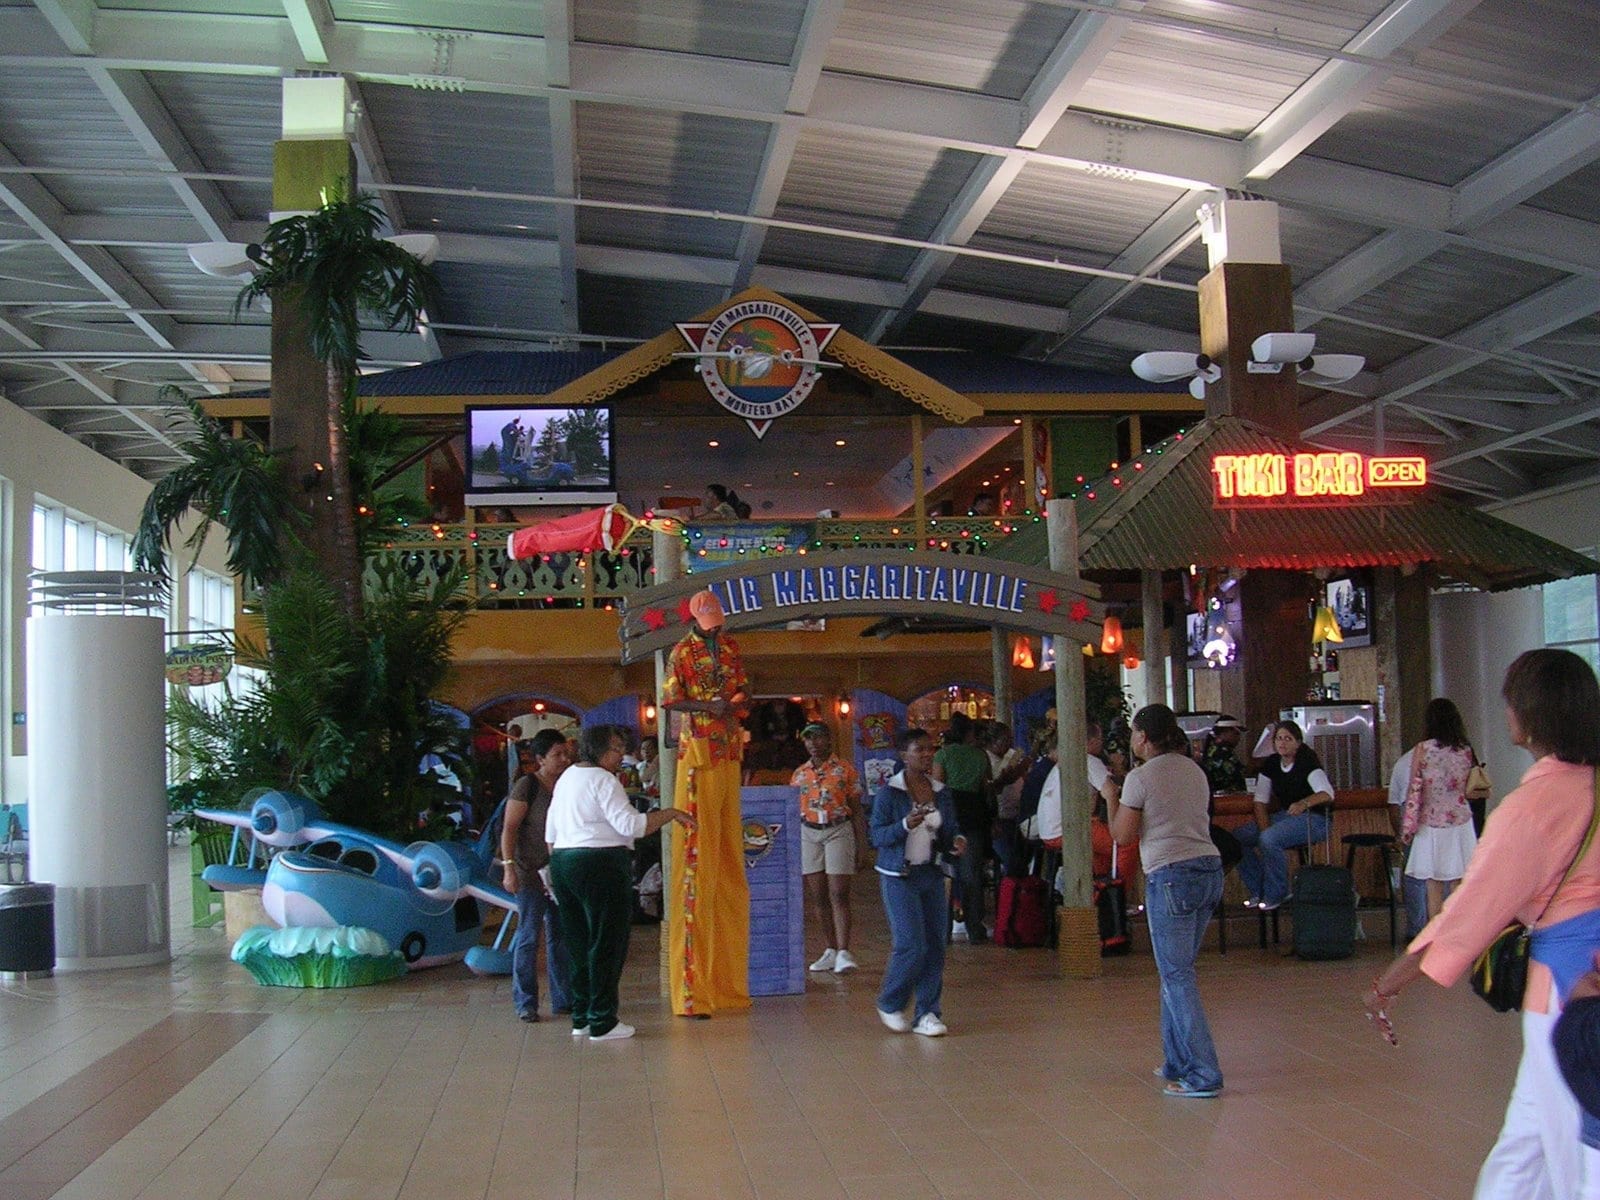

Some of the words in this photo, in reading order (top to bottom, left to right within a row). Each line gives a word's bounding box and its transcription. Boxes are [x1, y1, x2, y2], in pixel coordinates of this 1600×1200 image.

[710, 319, 728, 338] AIR
[725, 303, 808, 338] MARGARITAVILLE
[725, 395, 772, 415] MONTEGO
[776, 394, 797, 413] BAY
[1213, 453, 1287, 498] TIKI
[1294, 452, 1365, 497] BAR
[1372, 463, 1422, 481] OPEN
[708, 575, 763, 616] AIR
[772, 564, 1029, 613] MARGARITAVILLE
[205, 655, 230, 664] POST
